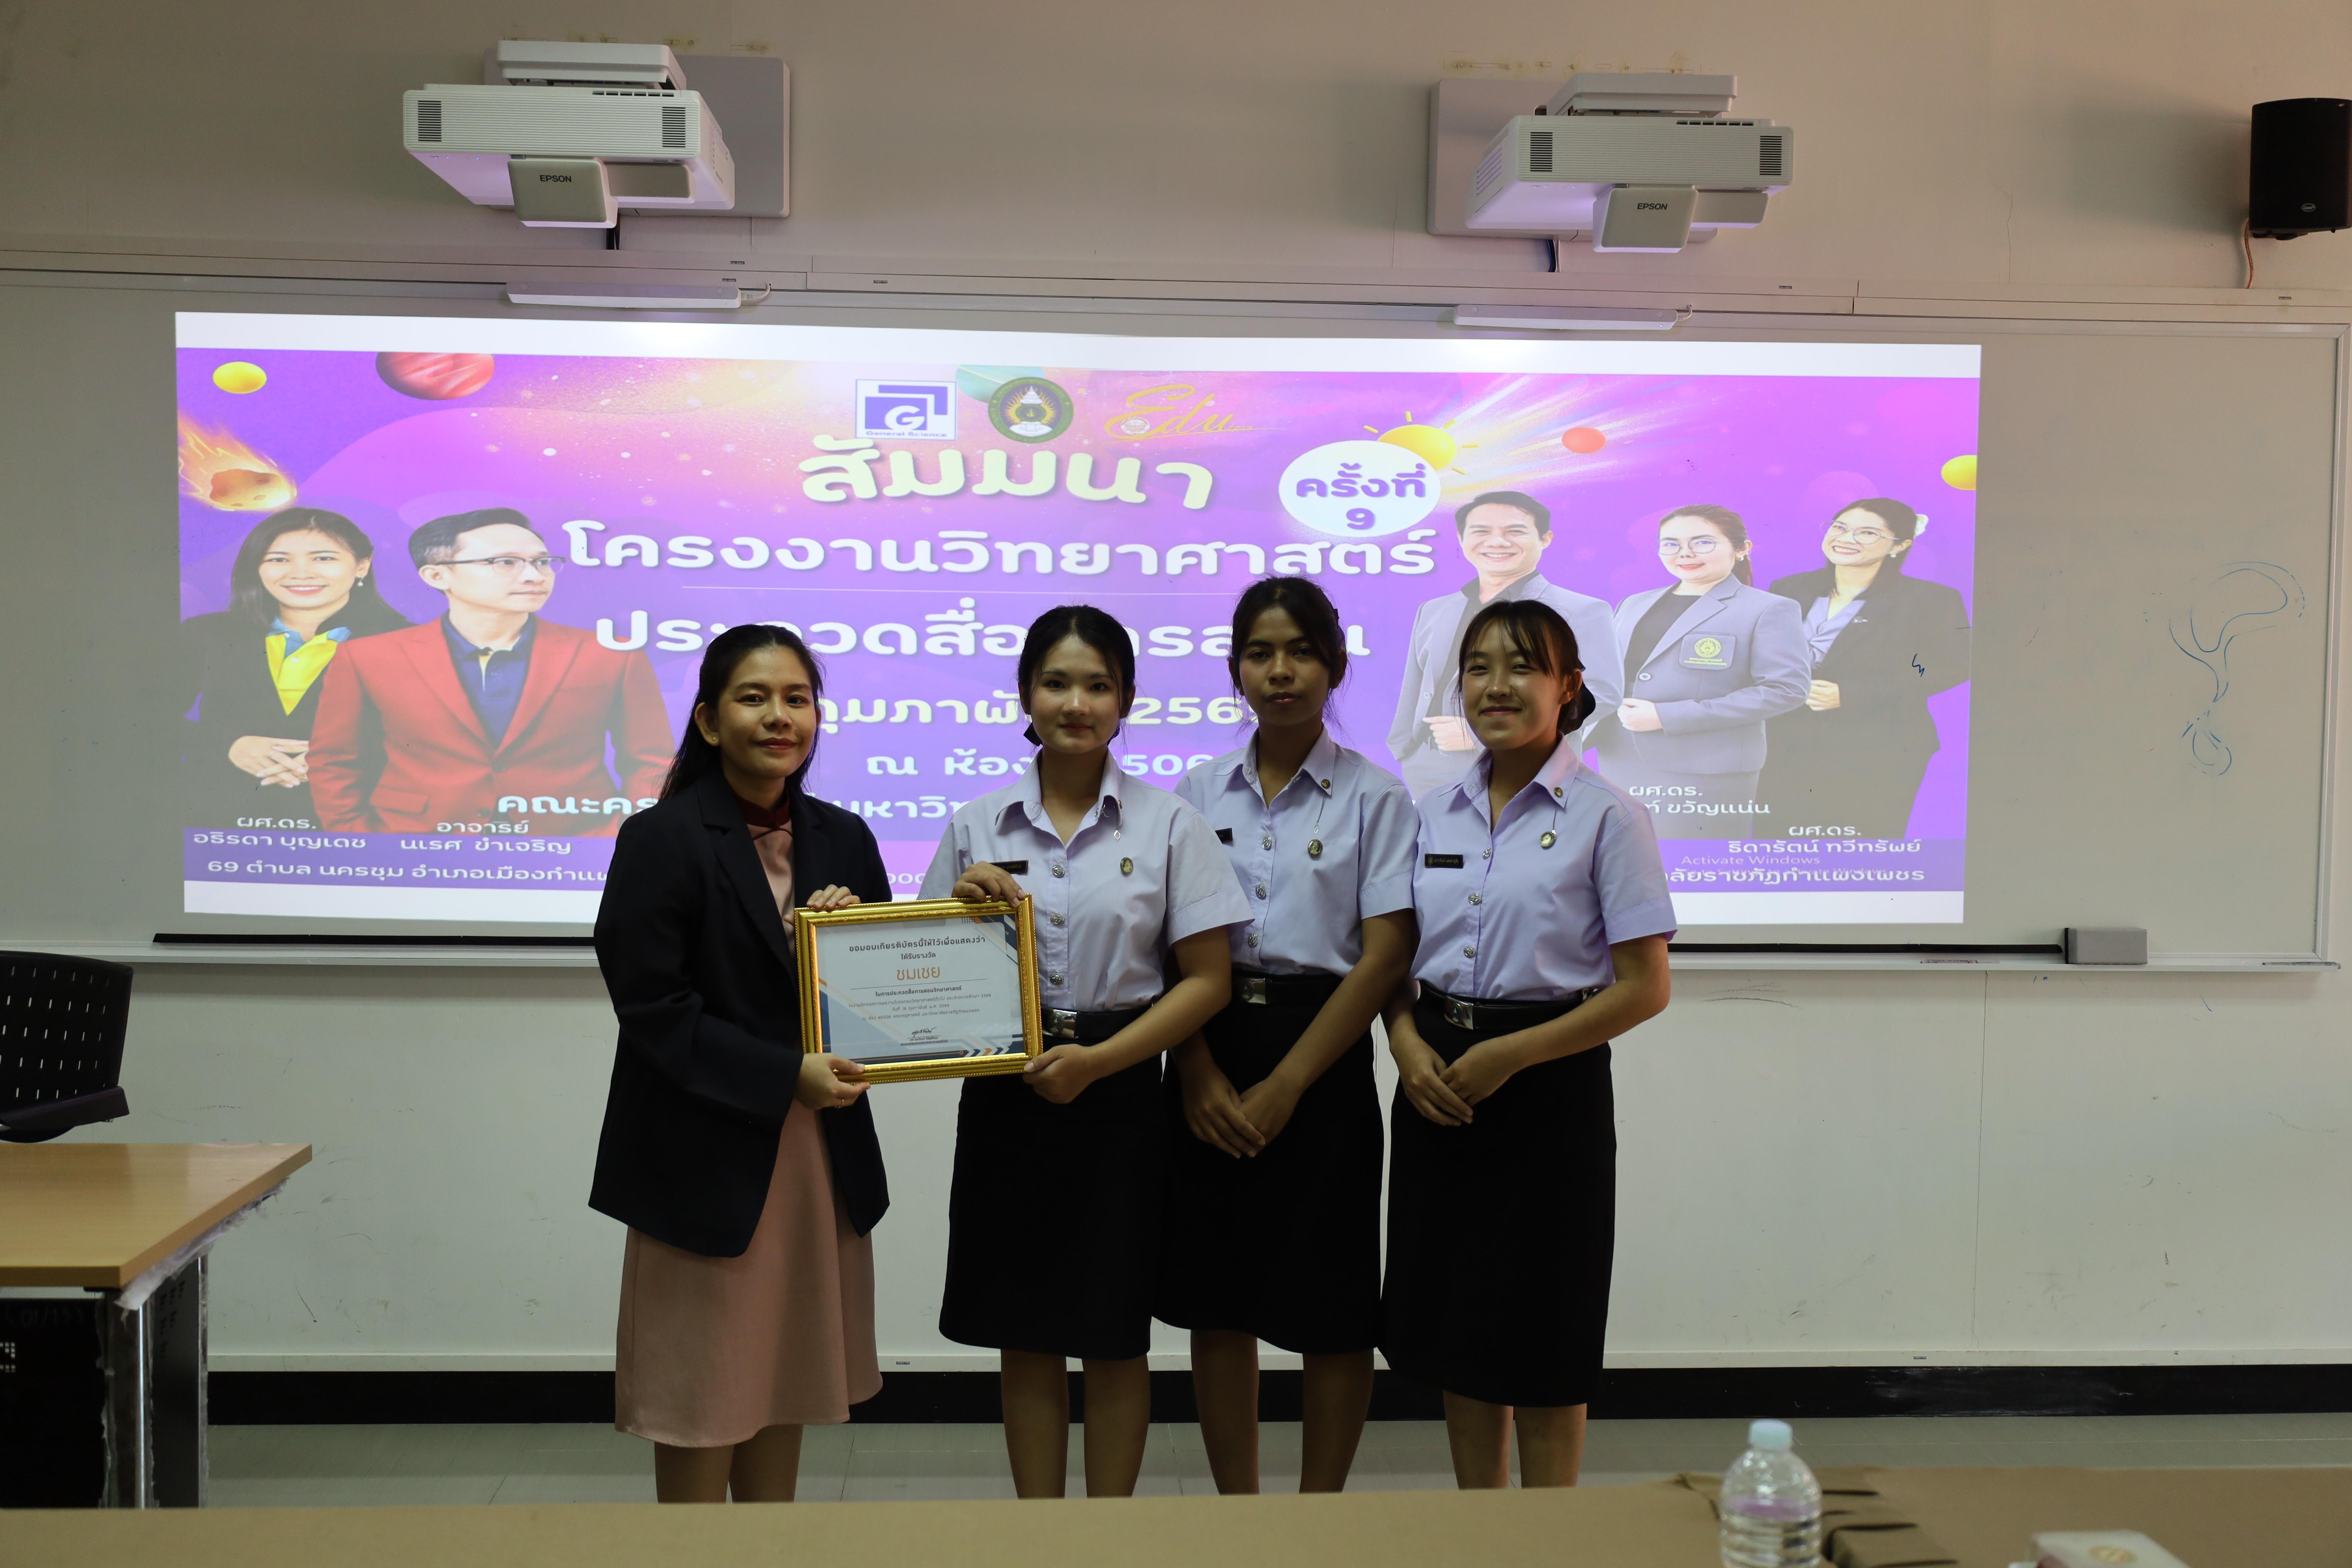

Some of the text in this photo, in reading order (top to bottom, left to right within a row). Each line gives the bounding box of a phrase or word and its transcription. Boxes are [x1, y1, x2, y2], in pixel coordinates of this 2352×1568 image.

[1105, 384, 1234, 440] Edu
[798, 434, 1213, 510] สัมมนา
[1296, 462, 1426, 498] ครั้งที่
[1346, 508, 1376, 530] 9
[562, 520, 1436, 575] โครงงานวิทยาศาสตร์
[1127, 697, 1259, 724] 256
[867, 756, 919, 775] ณ
[1629, 785, 1703, 796] ผศ.ดร.
[1667, 799, 1771, 816] ขวัญแน่น
[237, 817, 316, 829] ผศ.ดร.
[1788, 825, 1861, 836] ผศ.ดร.
[194, 831, 366, 850] อธิรดา บุญเดช
[401, 837, 571, 854] นเรศ ขำเจริญ
[1728, 839, 1921, 853] ธิดารัตน์ ทวีทรัพย์
[1681, 855, 1820, 865] Activate Windows
[208, 861, 239, 872] 69
[247, 860, 311, 875] ตำบล
[320, 865, 404, 881] นครชุม
[1665, 867, 1925, 884] ลัยราชภัฏกำแพงเพชร
[849, 935, 985, 952] ขอมอบเกียรติบัตรนี้ให้ไว้เพื่อแสดงว่า
[901, 952, 936, 960] ได้รับรางวัล
[896, 966, 940, 981] ชมเชย
[875, 985, 962, 997] ในการประกวดสื่อการสอนวิทยาศาสตร์
